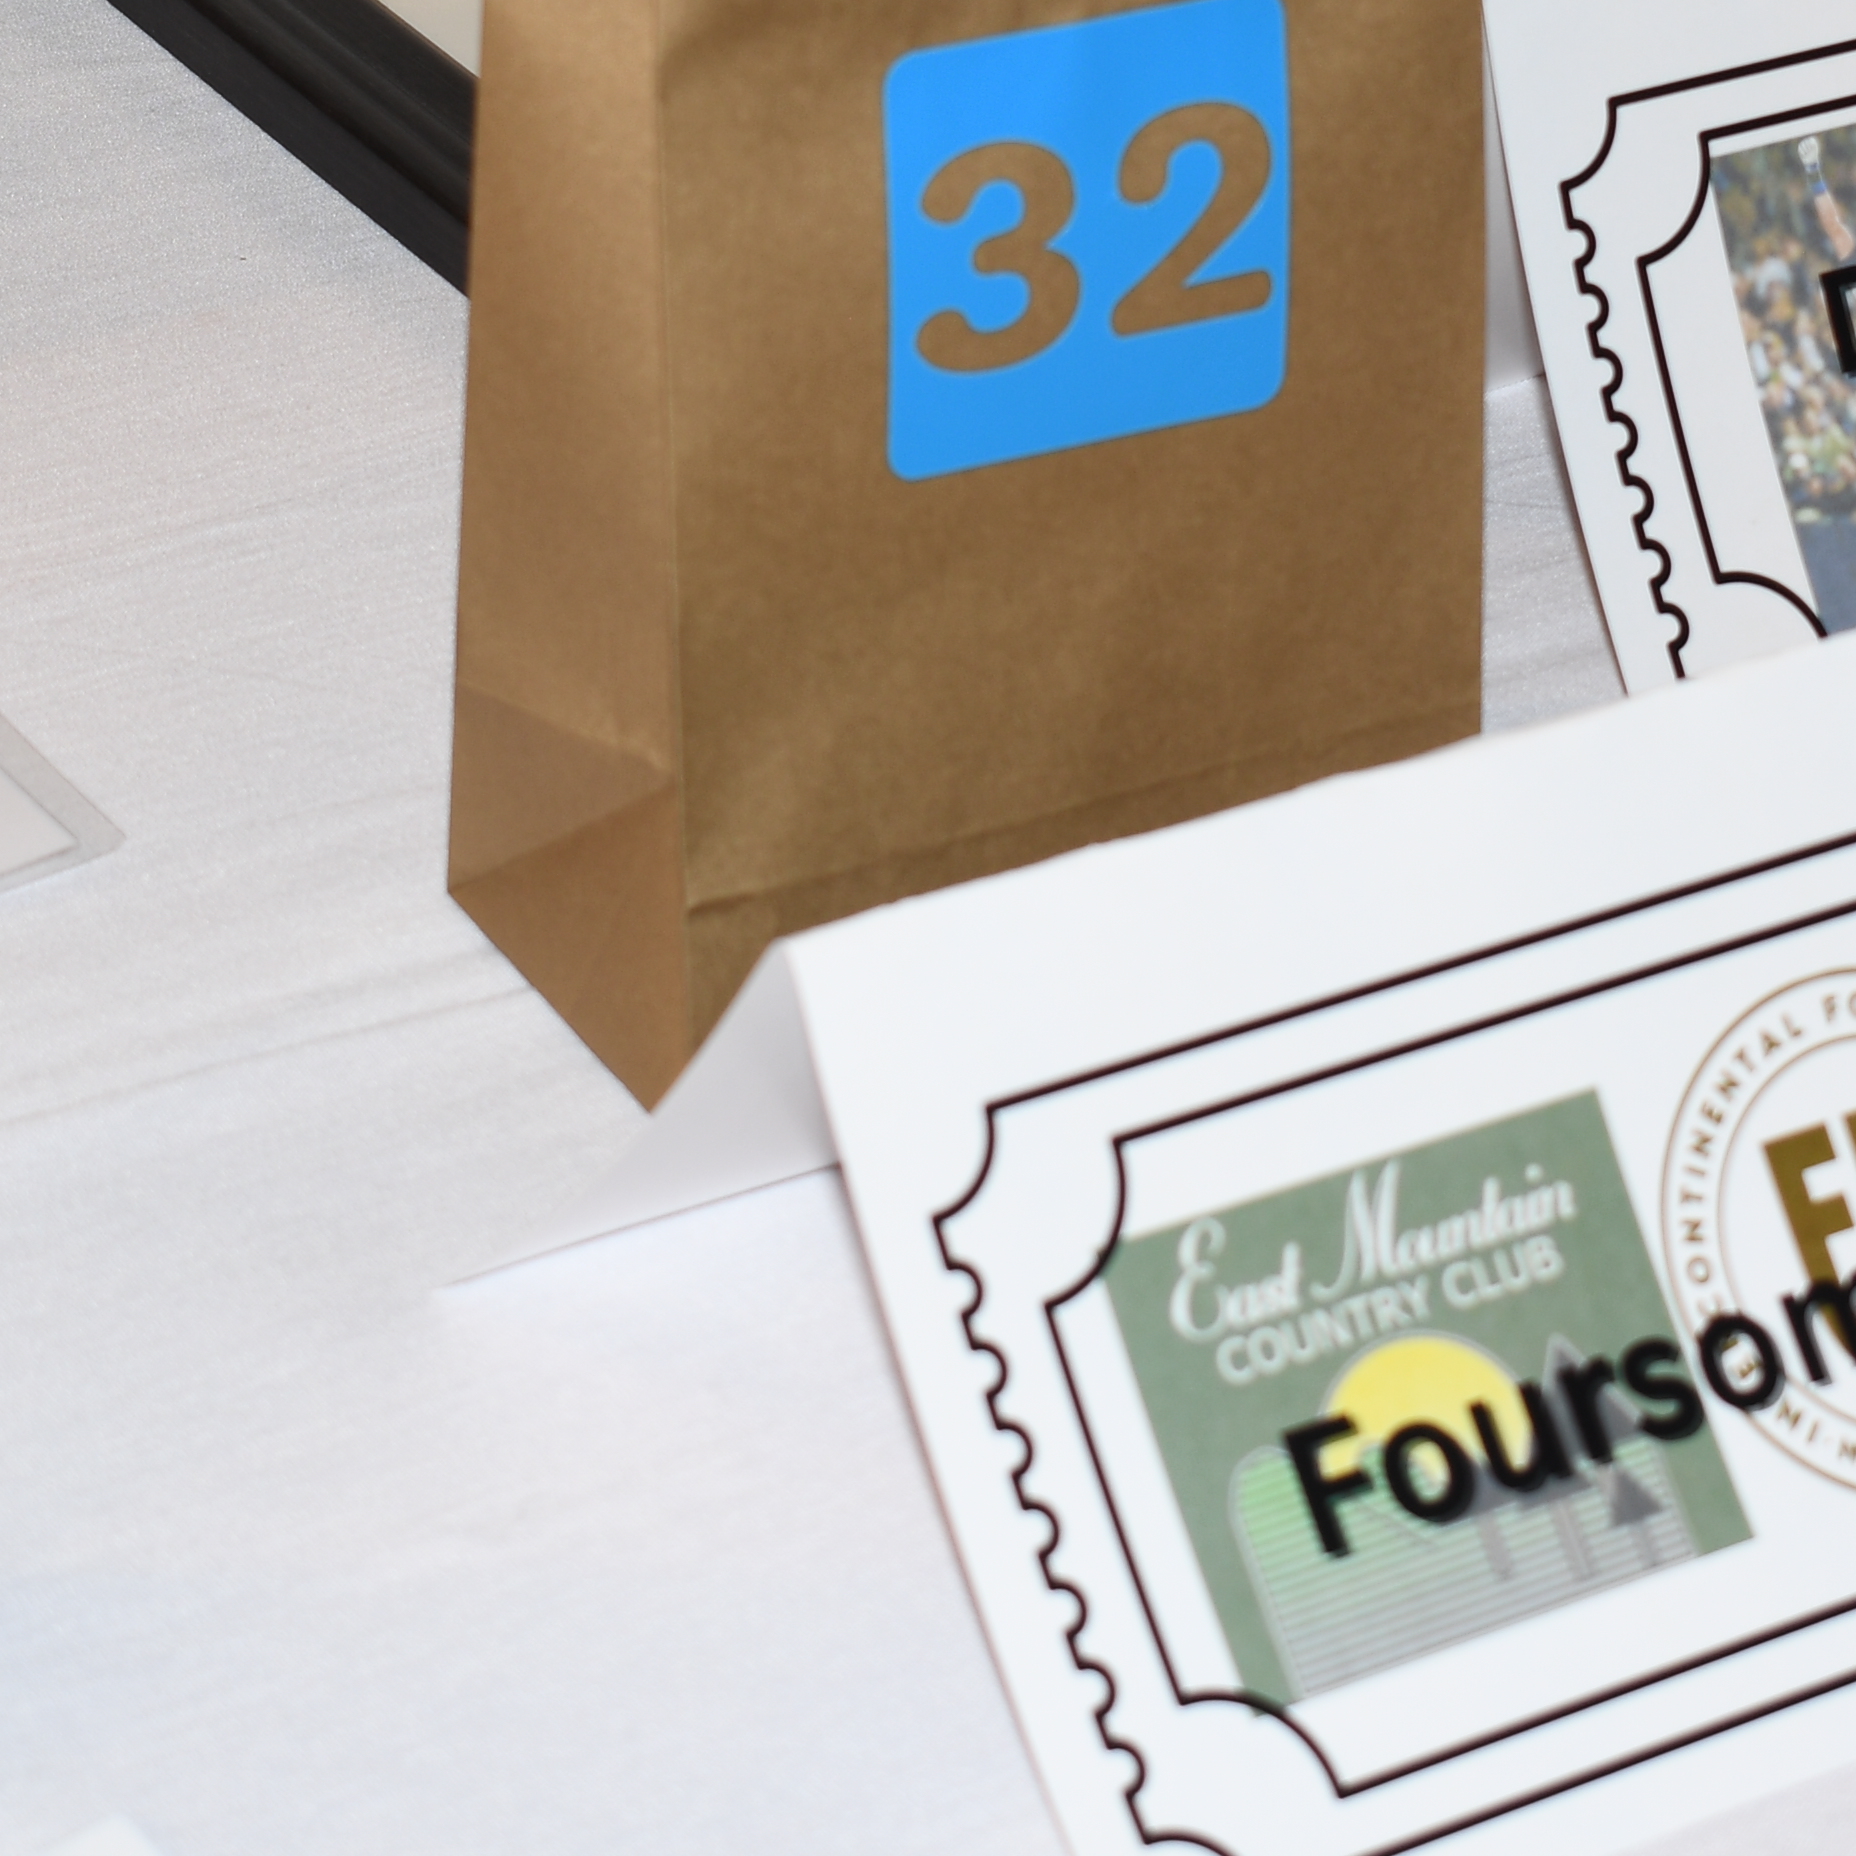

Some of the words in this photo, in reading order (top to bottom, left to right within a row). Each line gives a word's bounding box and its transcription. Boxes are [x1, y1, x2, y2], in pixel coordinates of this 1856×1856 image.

[914, 101, 1273, 374] 32
[1167, 1216, 1303, 1341] East
[1309, 1156, 1579, 1301] Mountain
[1215, 1274, 1431, 1386] COUNTRY
[1442, 1234, 1566, 1308] CLUB
